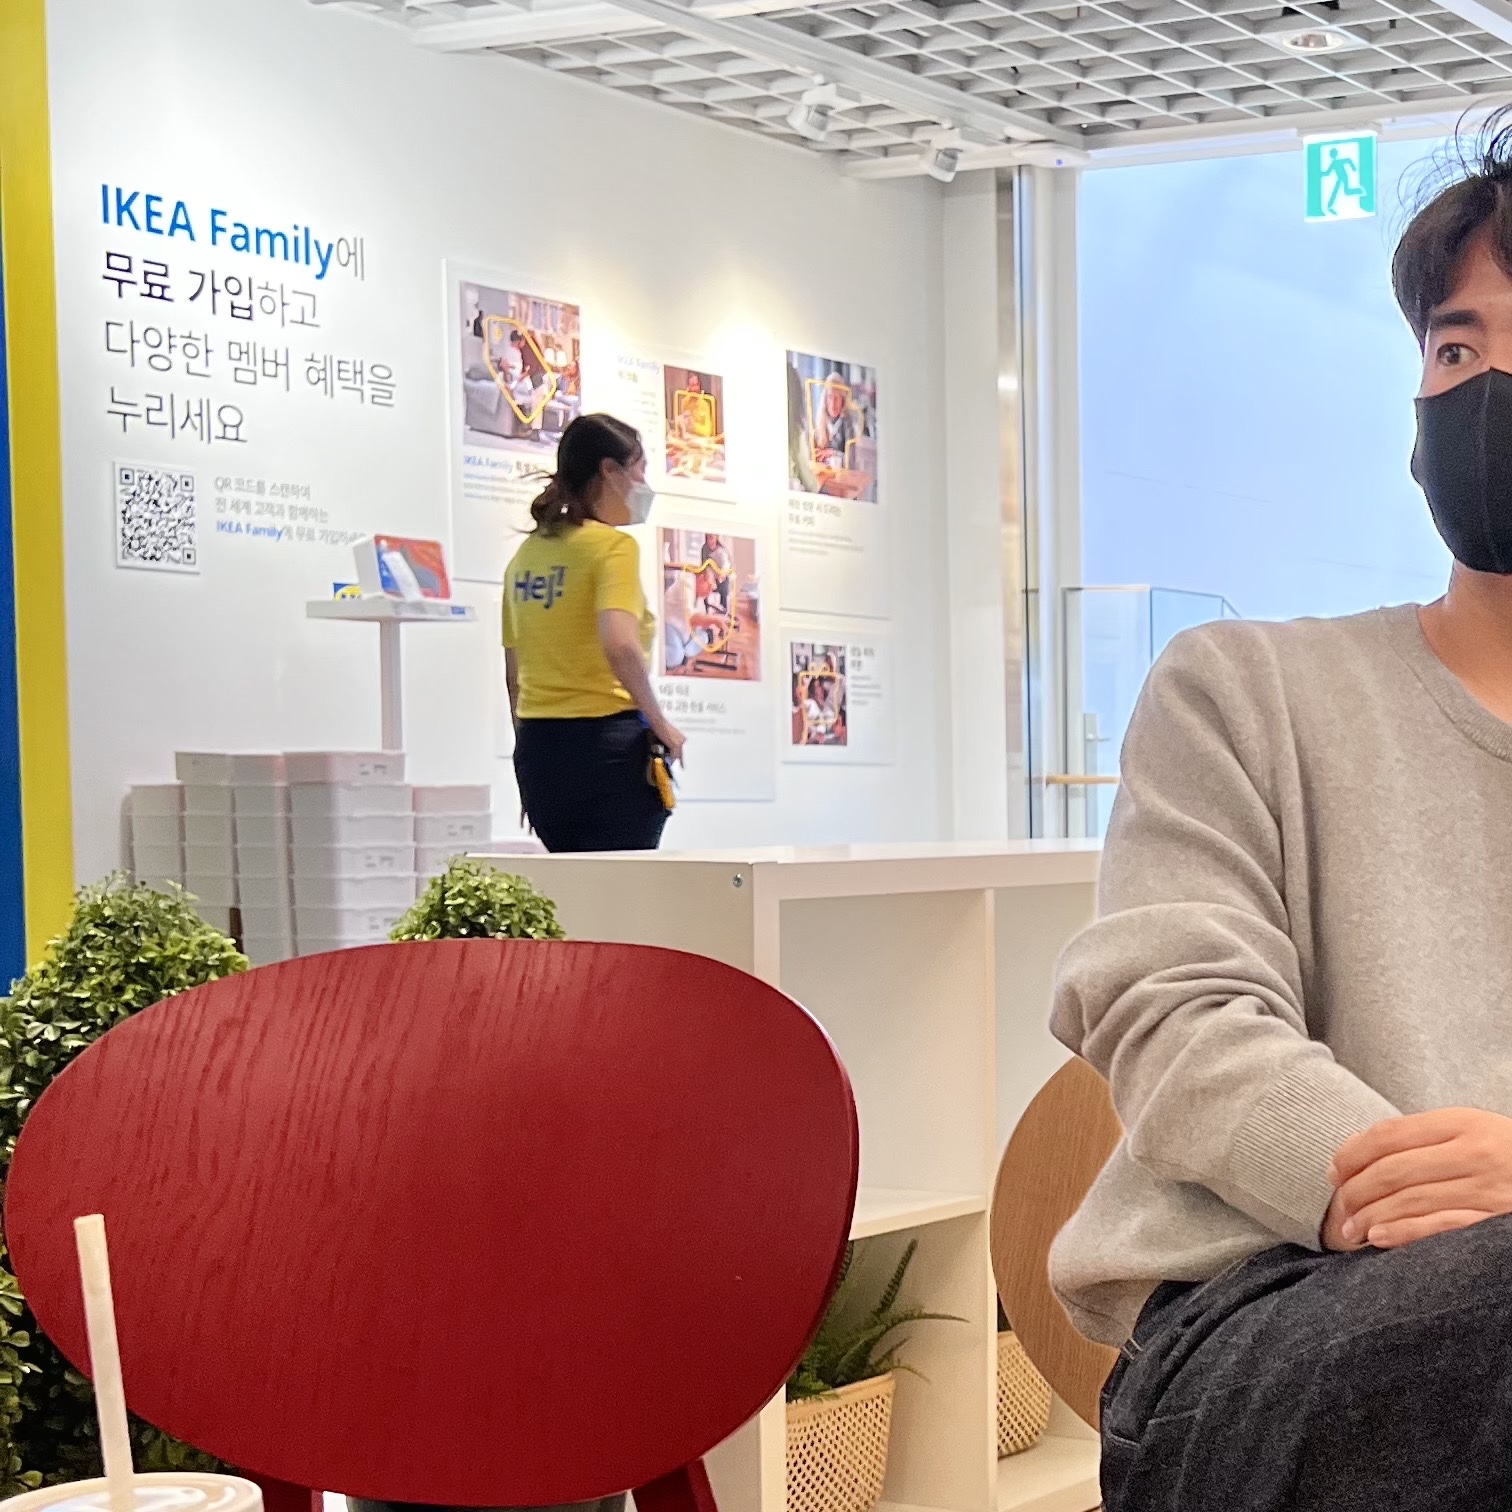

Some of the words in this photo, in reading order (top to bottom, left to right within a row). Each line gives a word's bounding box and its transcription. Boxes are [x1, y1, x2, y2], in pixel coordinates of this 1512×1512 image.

[101, 183, 196, 242] IKEA
[210, 208, 366, 281] Family에
[102, 250, 174, 303] 무료
[188, 270, 321, 328] 가입하고
[105, 319, 214, 377] 다양한
[228, 340, 290, 393] 멤버
[305, 353, 397, 407] 혜택을
[107, 386, 248, 444] 누리세요
[214, 476, 232, 492] QR
[216, 520, 243, 534] IKEA
[514, 565, 568, 610] Hej!
